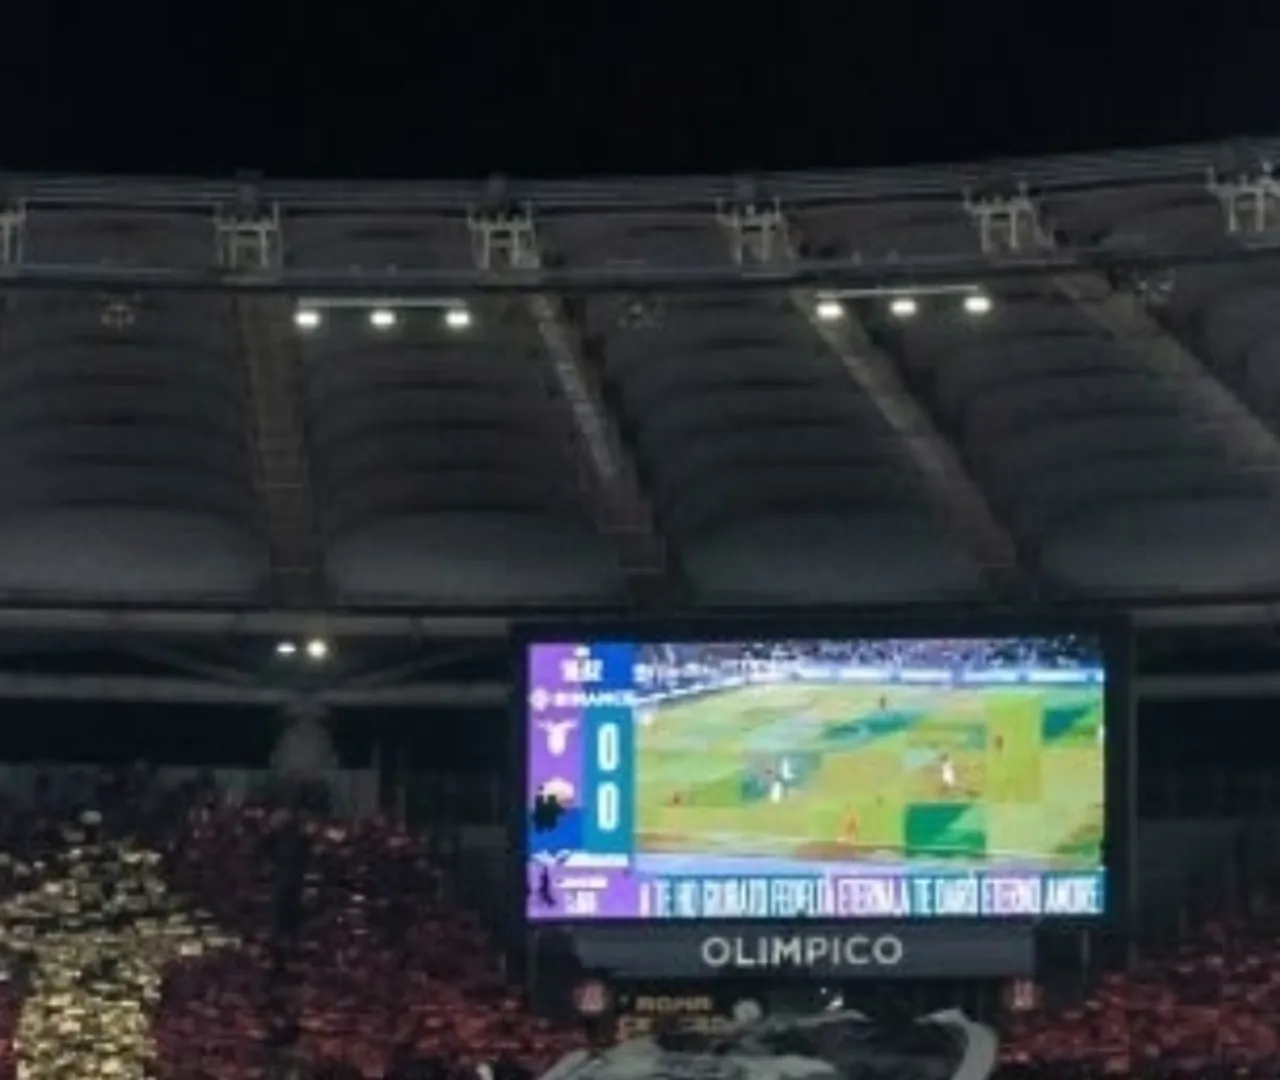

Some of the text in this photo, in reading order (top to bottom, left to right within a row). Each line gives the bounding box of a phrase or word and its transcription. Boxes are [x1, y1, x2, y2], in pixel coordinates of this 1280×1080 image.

[598, 722, 619, 772] 0
[598, 782, 619, 832] 0
[701, 935, 903, 967] OLIMPICO
